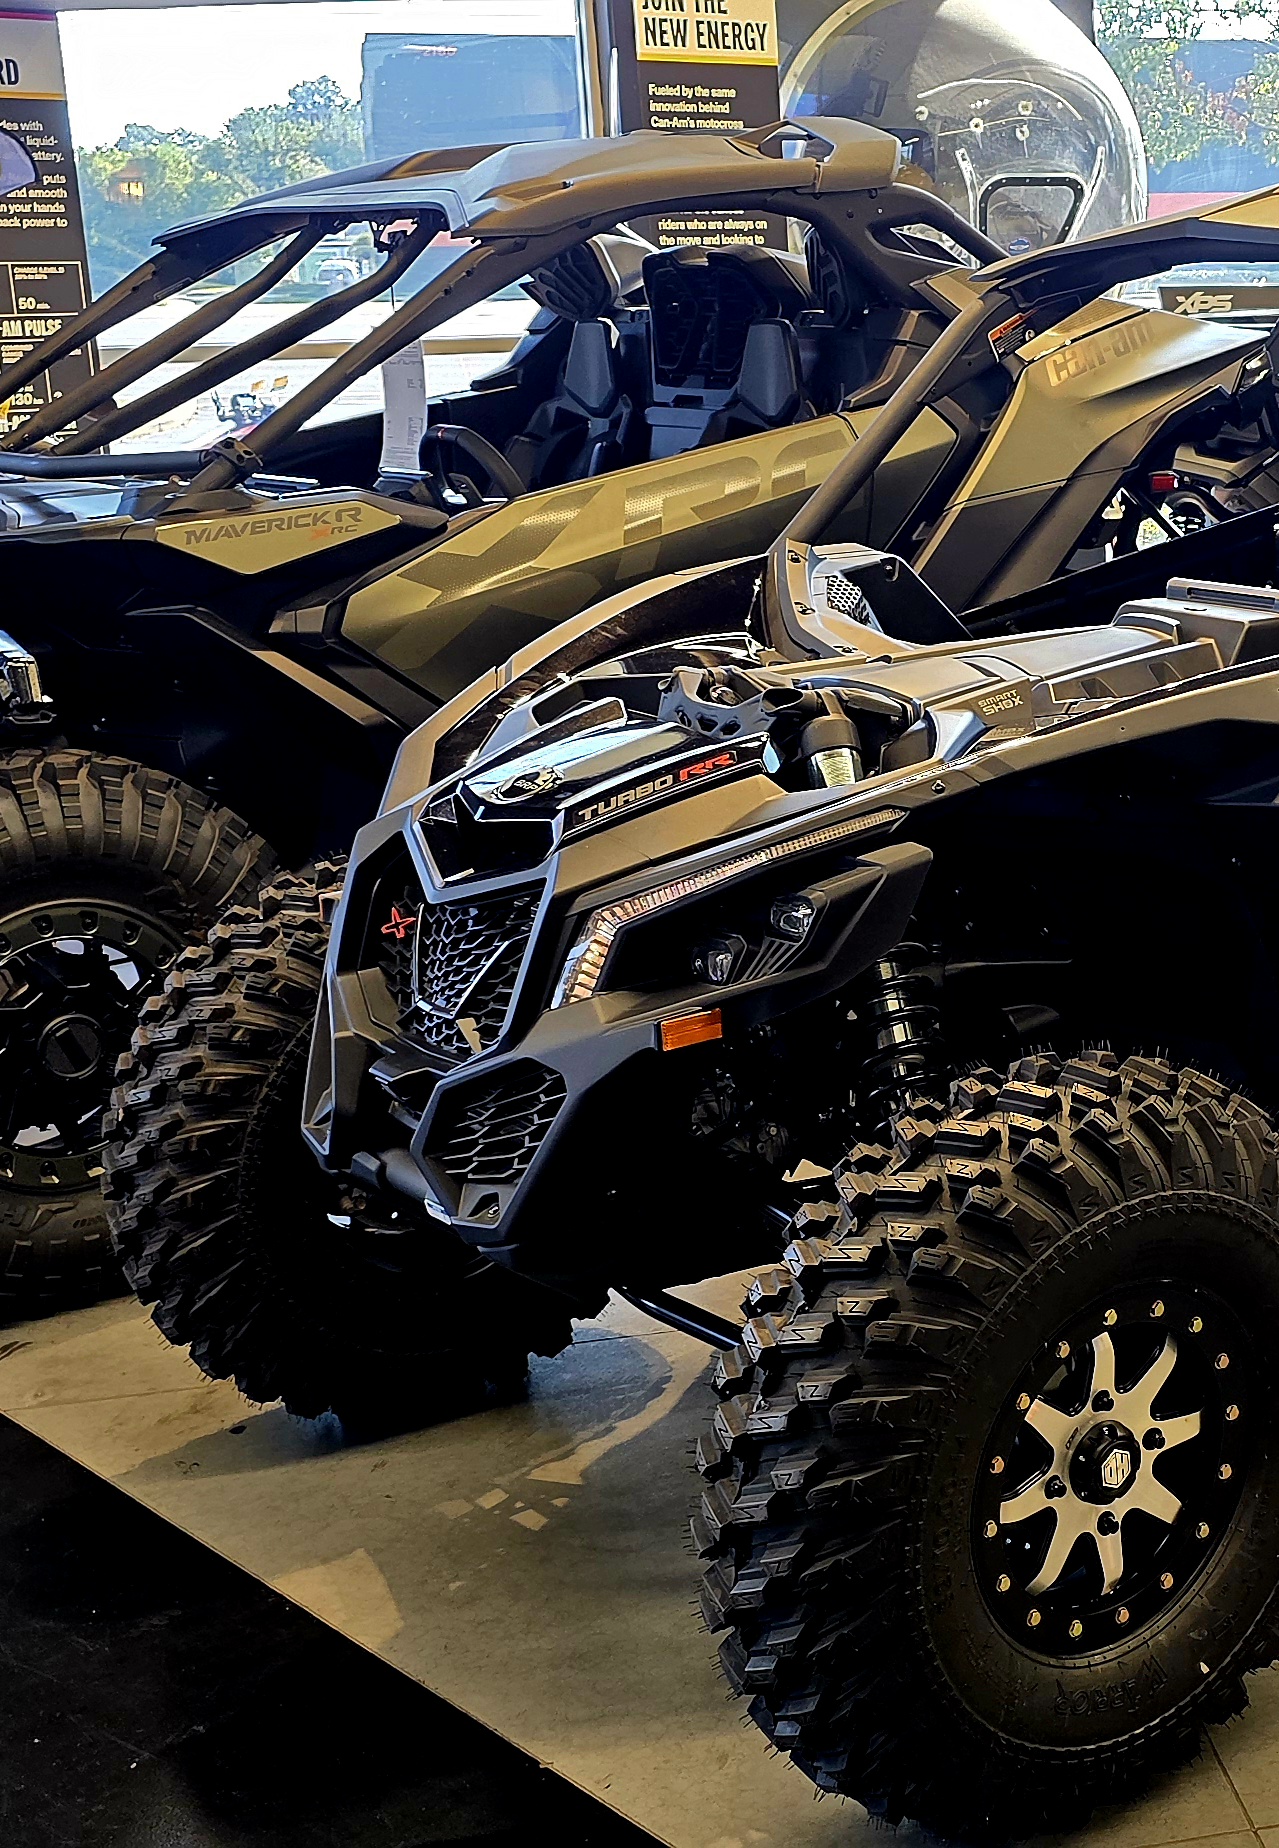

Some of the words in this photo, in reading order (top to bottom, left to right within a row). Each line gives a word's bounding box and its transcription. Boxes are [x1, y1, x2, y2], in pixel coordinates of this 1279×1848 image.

[643, 17, 688, 47] NEW
[695, 20, 768, 51] ENERGY
[648, 83, 680, 96] Fueled
[681, 85, 693, 98] by
[694, 86, 709, 97] the
[711, 88, 736, 98] same
[649, 100, 697, 112] innovation
[698, 102, 730, 113] behind
[20, 120, 43, 131] with
[650, 115, 695, 128] Can-Am's
[696, 119, 744, 129] motocross
[42, 173, 66, 186] puts
[28, 187, 68, 198] smooth
[8, 203, 32, 215] your
[33, 201, 65, 212] hands
[22, 218, 55, 229] power
[56, 217, 68, 227] to
[658, 219, 685, 231] riders
[686, 219, 707, 230] who
[708, 221, 723, 230] are
[724, 219, 754, 231] always
[755, 220, 768, 230] on
[659, 234, 676, 245] the
[677, 236, 701, 246] move
[703, 234, 720, 245] and
[721, 233, 753, 246] looking
[754, 234, 765, 245] to
[18, 297, 36, 310] 50
[1173, 291, 1235, 314] XPS
[184, 510, 333, 545] MAVERICK
[334, 506, 363, 524] R
[978, 689, 1018, 708] SMART
[982, 696, 1024, 716] SHOX
[578, 774, 674, 821] TURBO
[679, 753, 734, 782] RR
